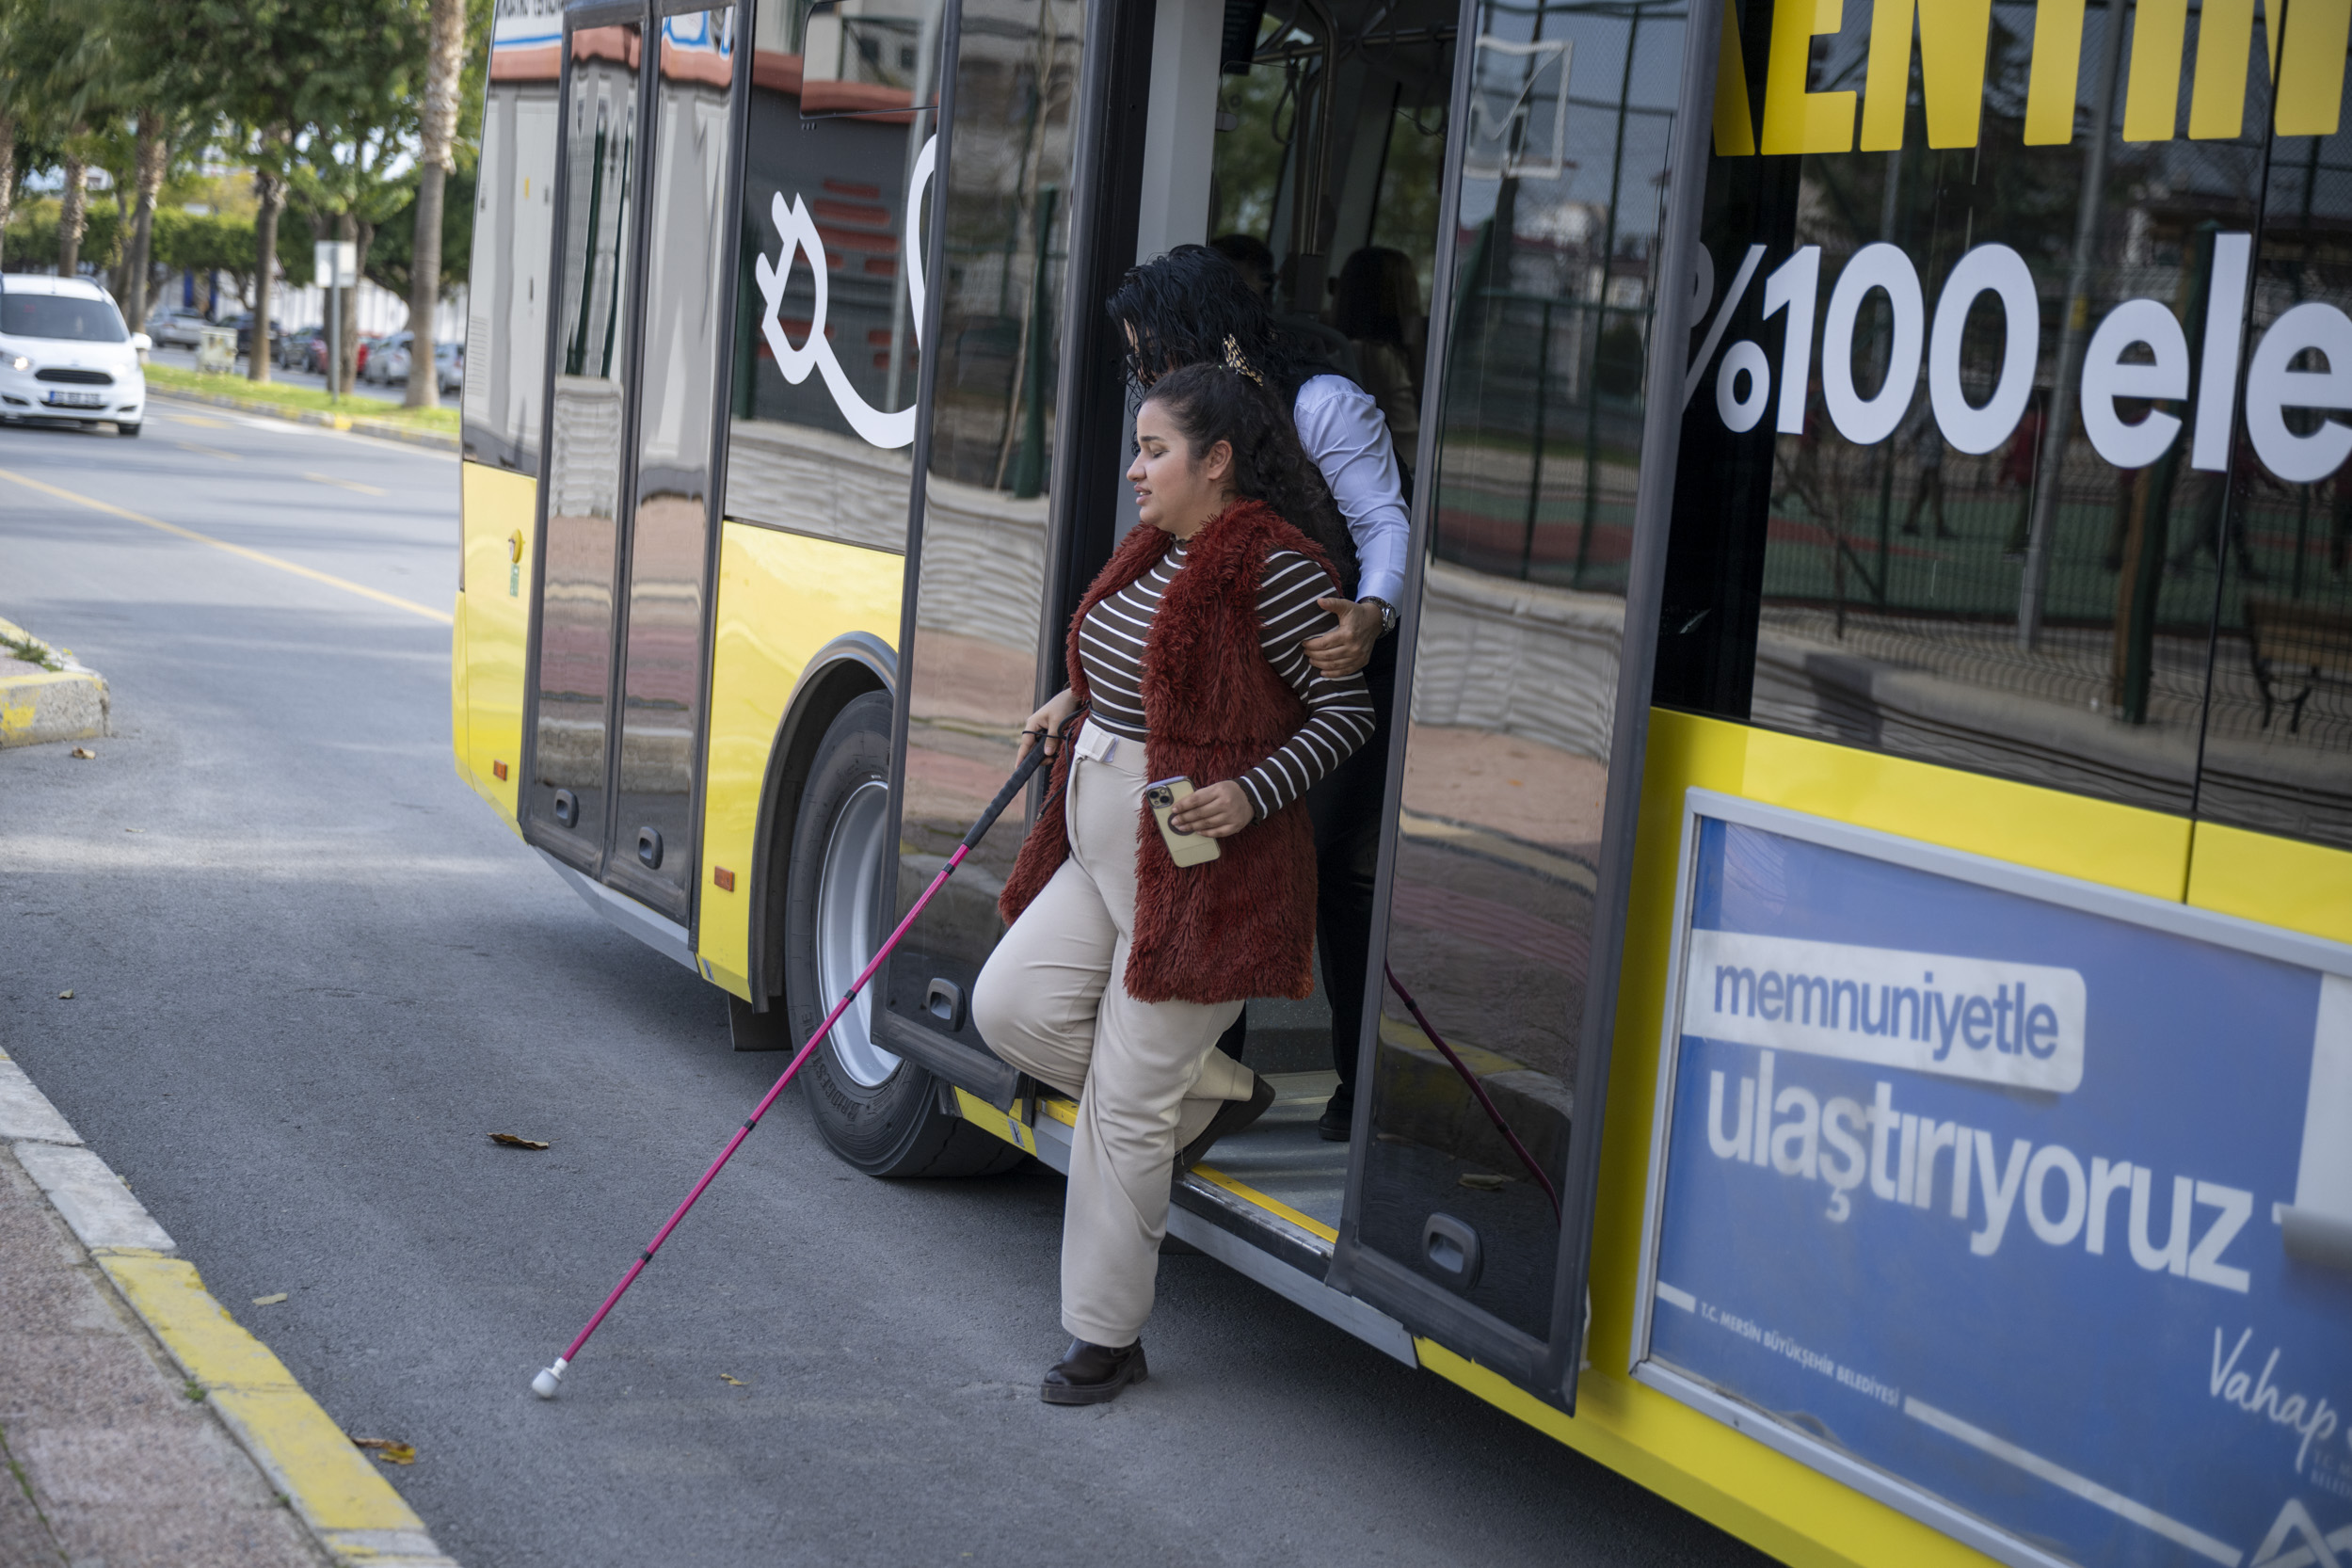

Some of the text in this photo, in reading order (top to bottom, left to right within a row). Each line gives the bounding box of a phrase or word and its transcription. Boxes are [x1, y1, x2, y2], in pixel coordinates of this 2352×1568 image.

[1684, 232, 2352, 484] %100 ele
[1713, 963, 2059, 1062] memnuniyetle
[1706, 1049, 2254, 1294] ulaştırıyoruz
[1701, 1302, 1900, 1408] T.C. MERSİN BÜYÜKŞEHİR BELEDİYESİ
[2210, 1326, 2339, 1475] Vahap
